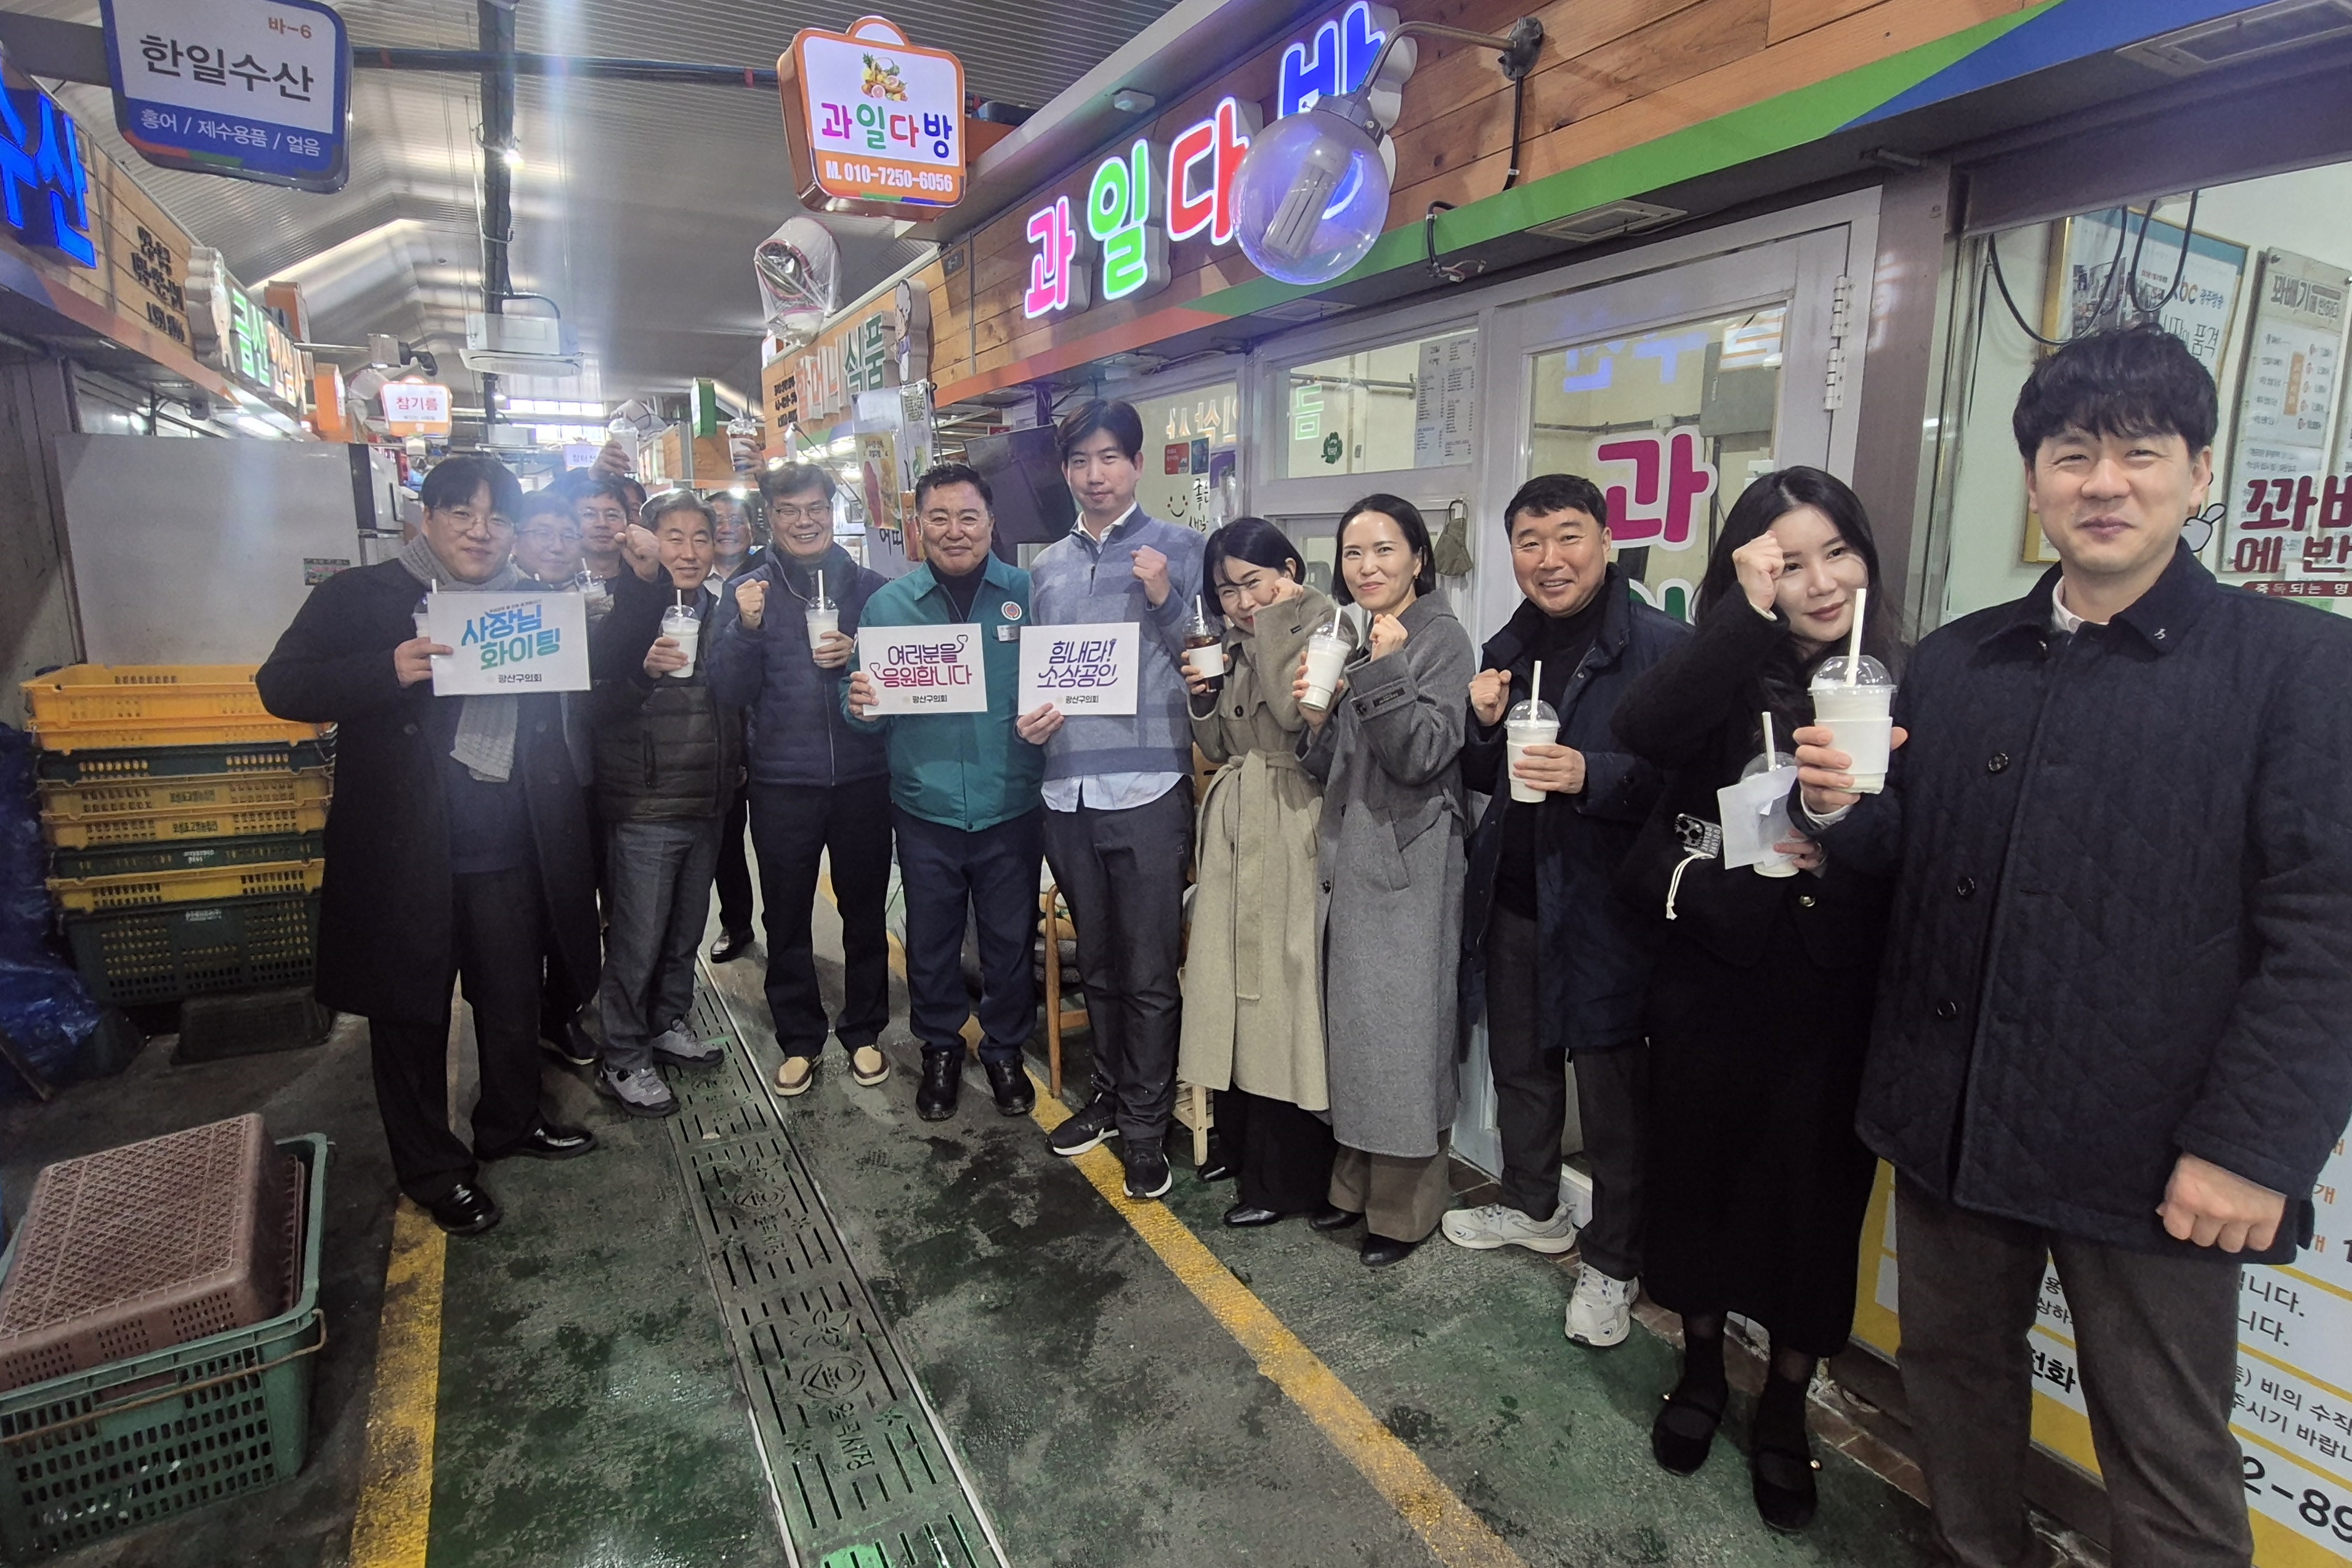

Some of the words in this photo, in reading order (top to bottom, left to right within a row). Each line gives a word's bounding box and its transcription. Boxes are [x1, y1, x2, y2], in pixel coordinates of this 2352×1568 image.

[268, 17, 312, 39] 바-6
[140, 34, 315, 103] 한일수산
[140, 108, 178, 132] 홍어
[197, 120, 269, 148] 제수용품
[286, 134, 321, 158] 얼음
[821, 102, 953, 159] 과일다방
[844, 162, 954, 193] 010-7250-6056
[2191, 323, 2220, 359] 품격
[395, 396, 439, 411] 참기름
[2234, 536, 2284, 574] 에
[460, 604, 542, 647] 사장님
[480, 627, 560, 671] 화이팅
[887, 638, 966, 666] 여러분을
[1048, 638, 1117, 665] 힘내라!
[498, 673, 543, 684] 광산구의회
[881, 664, 973, 688] 응원합니다
[1037, 663, 1118, 688] 소상공인
[911, 694, 948, 704] 광산구의회
[1065, 695, 1099, 705] 광산구의회
[2260, 1377, 2302, 1412] 비의
